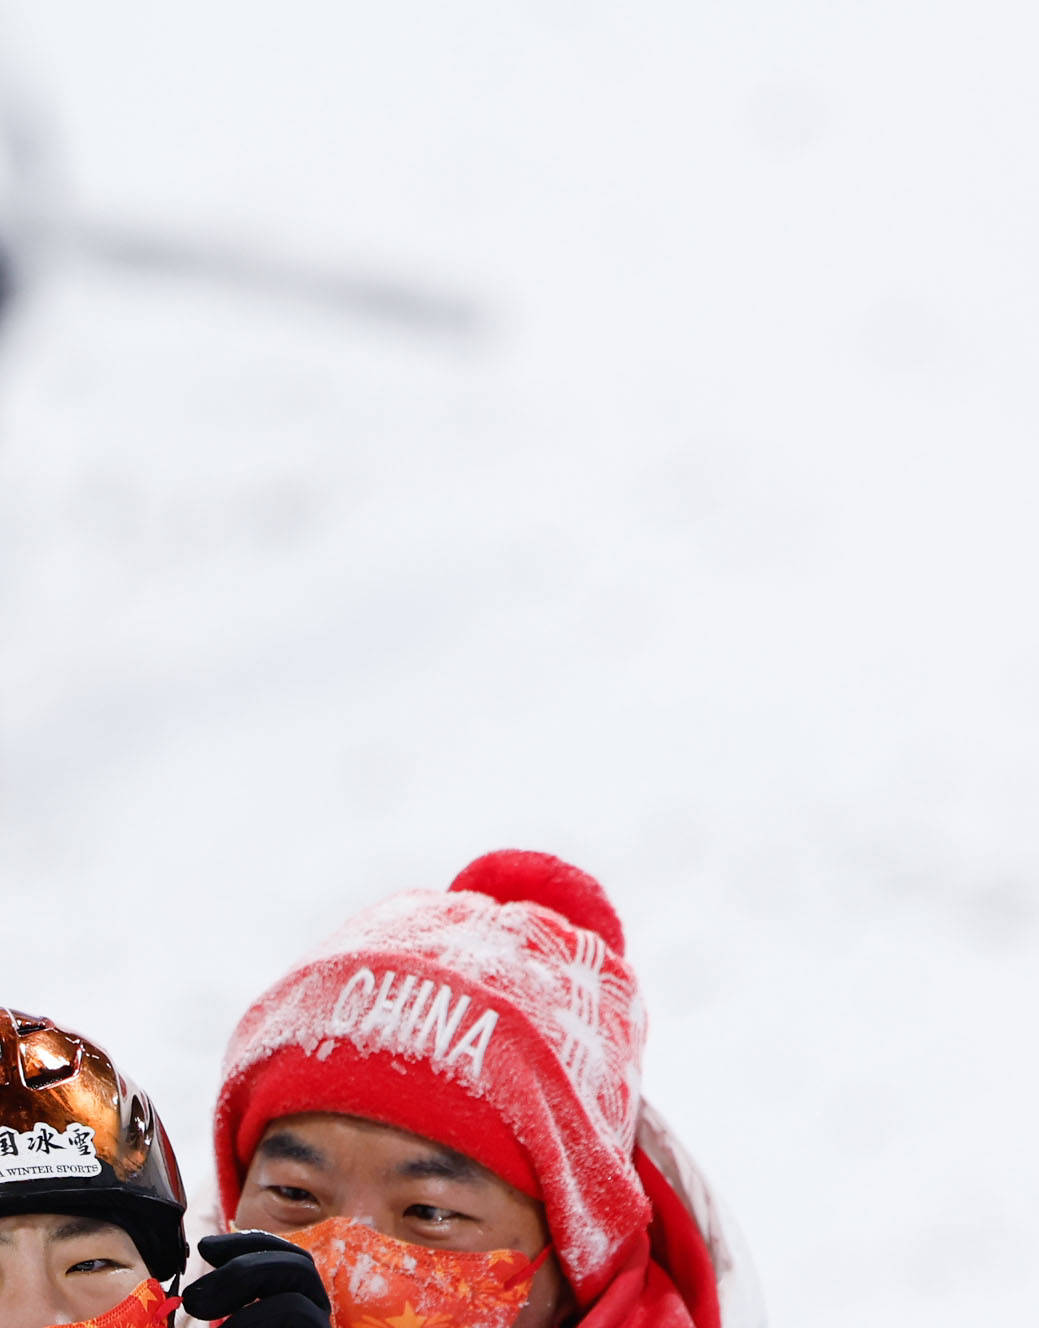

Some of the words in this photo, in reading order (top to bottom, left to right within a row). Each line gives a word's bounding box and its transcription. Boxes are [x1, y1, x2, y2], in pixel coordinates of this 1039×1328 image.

[331, 966, 500, 1079] CHINA
[6, 1164, 53, 1176] WINTER
[56, 1164, 99, 1175] SPORTS
